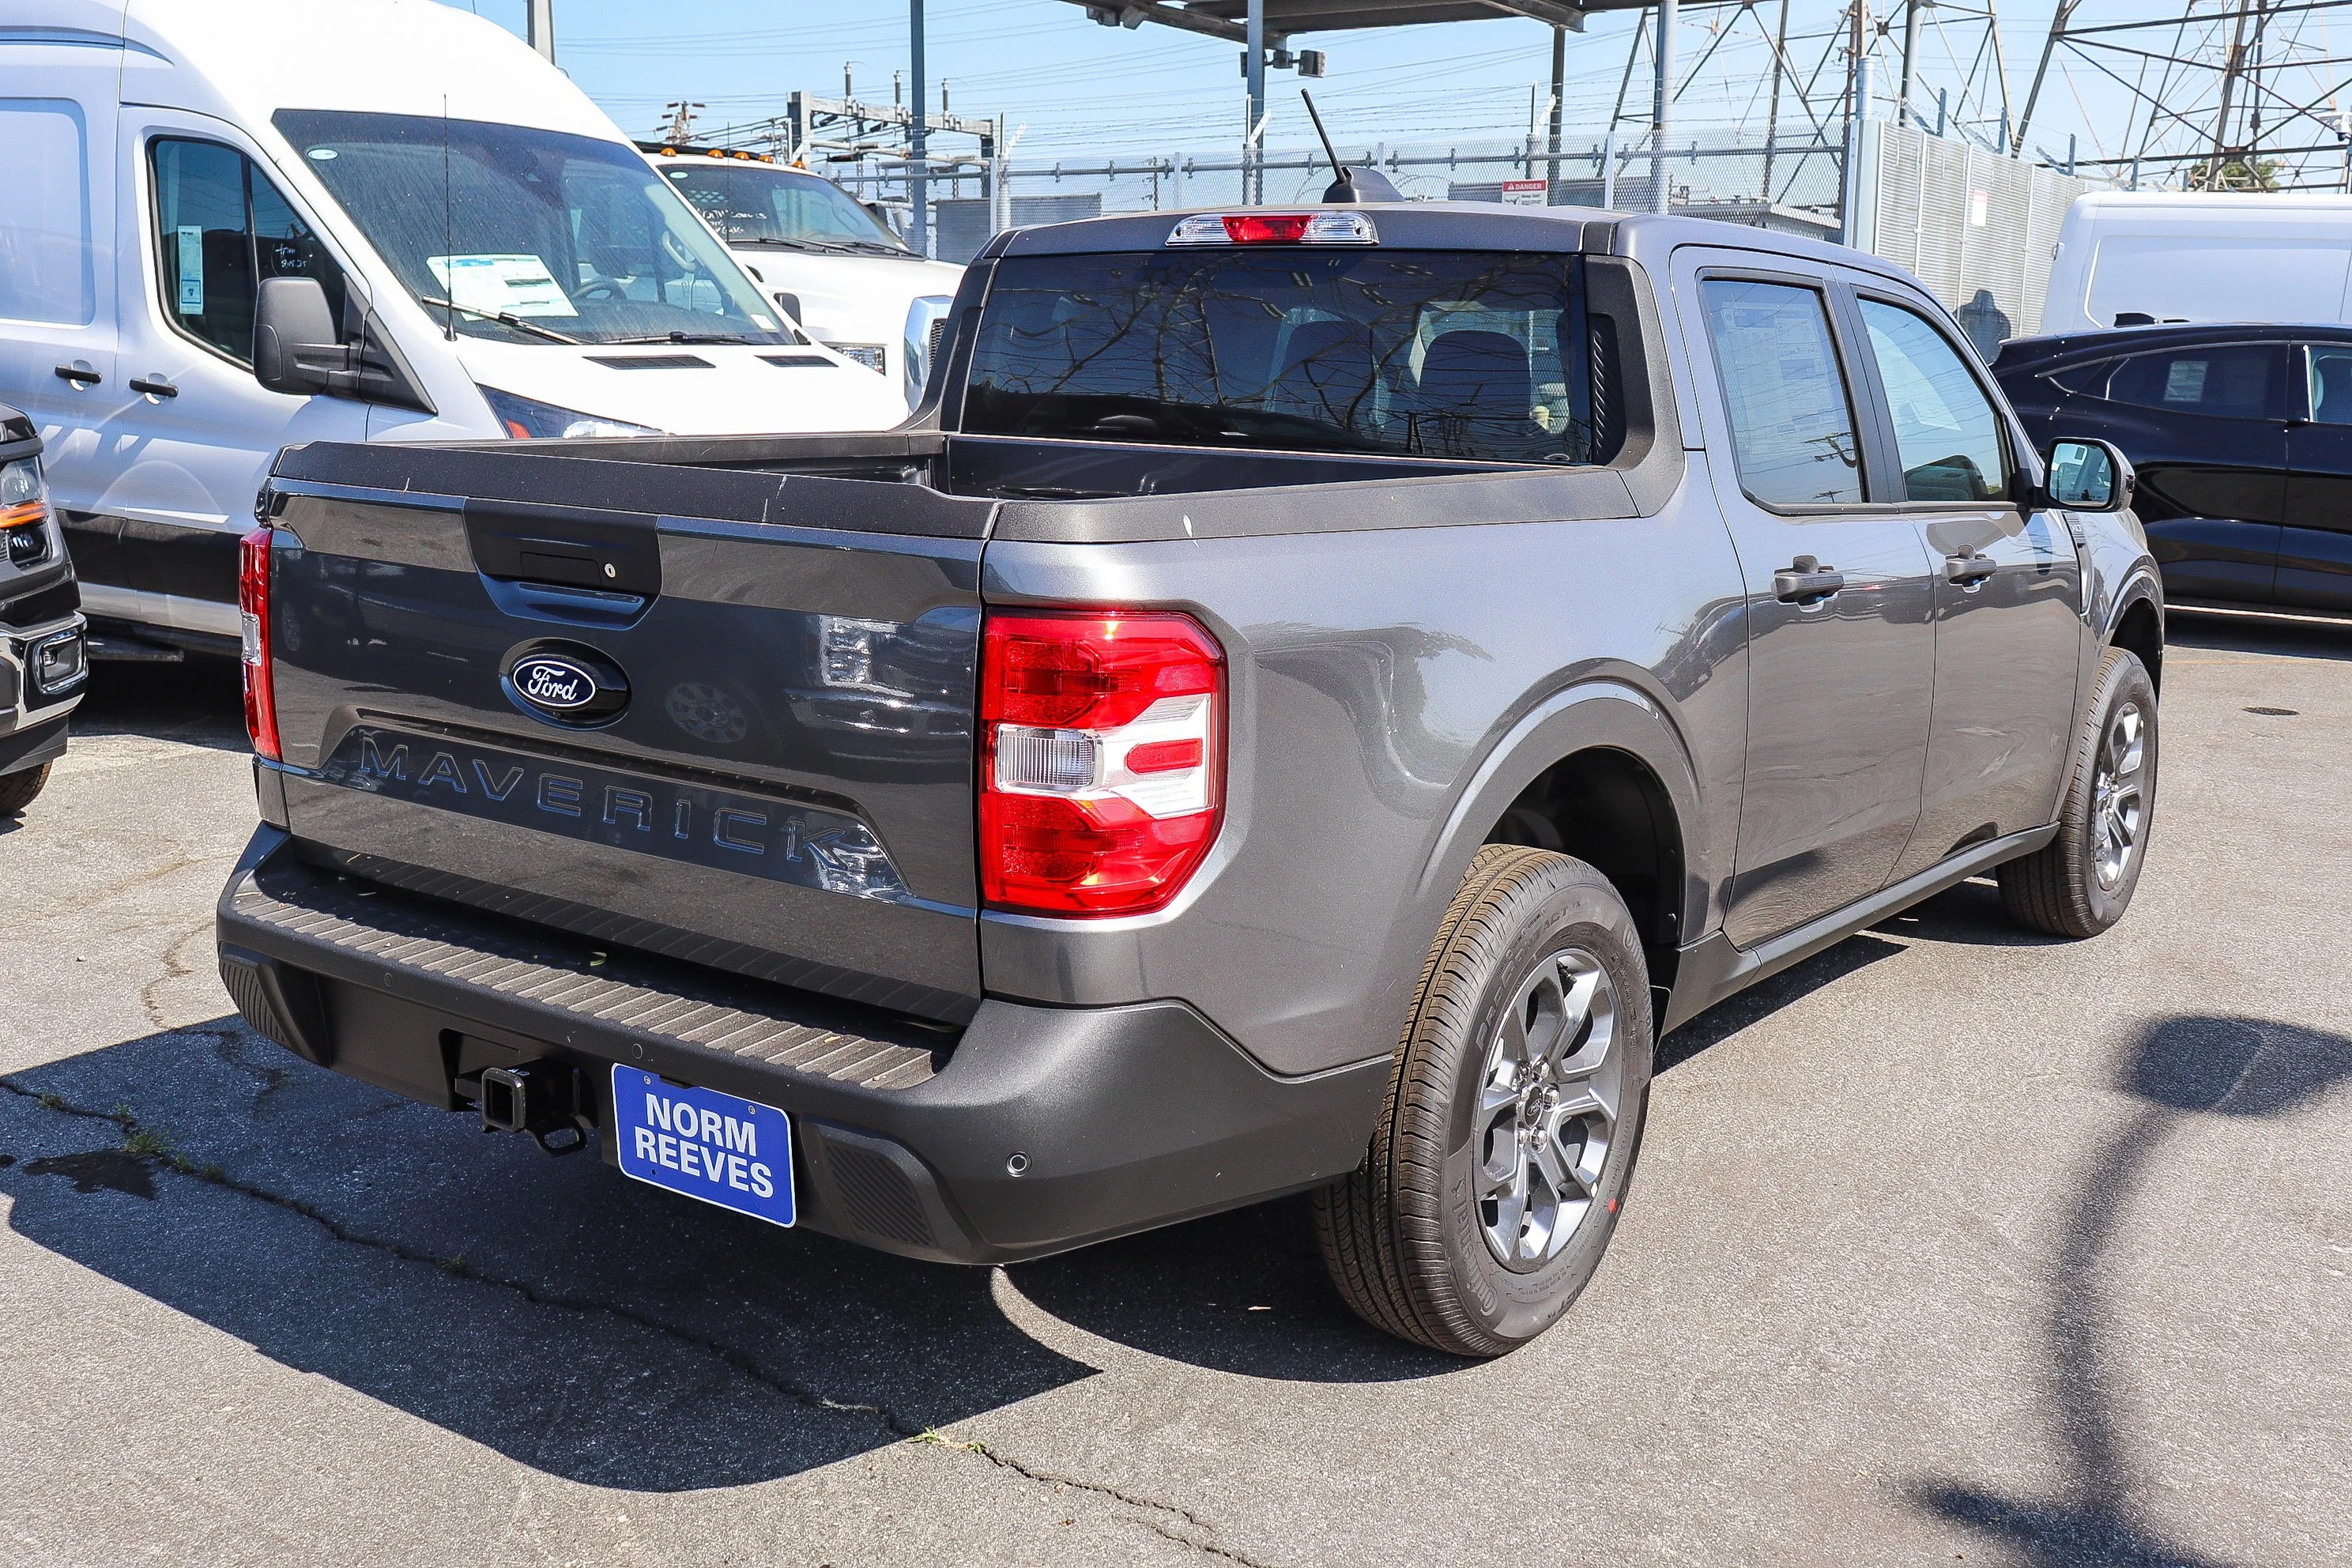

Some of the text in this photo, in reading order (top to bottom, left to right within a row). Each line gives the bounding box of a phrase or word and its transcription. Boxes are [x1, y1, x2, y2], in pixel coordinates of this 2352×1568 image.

[527, 665, 579, 702] Ford
[360, 735, 851, 873] MAVERICK
[645, 1092, 757, 1157] NORM
[634, 1125, 775, 1199] REEVES
[1452, 1206, 1498, 1317] Continental
